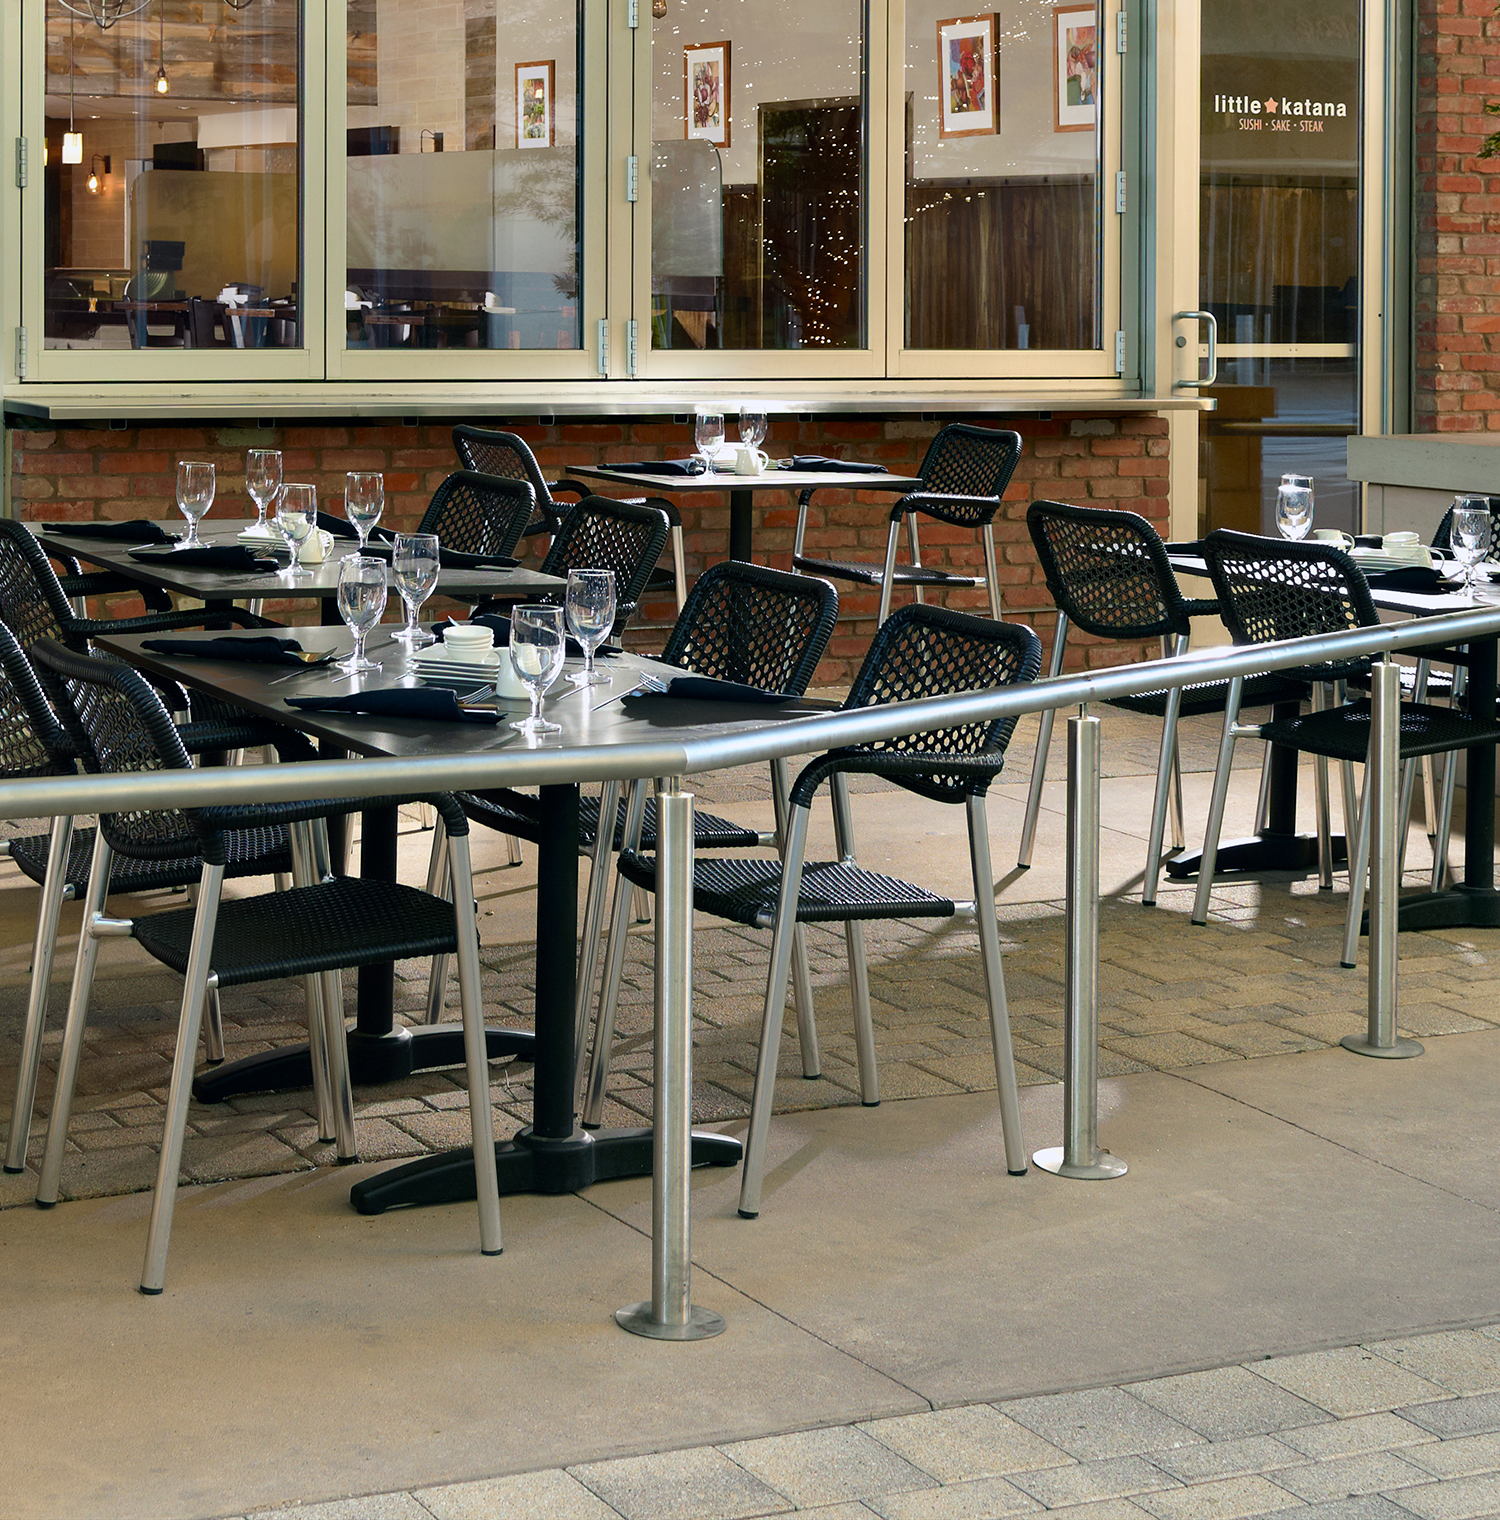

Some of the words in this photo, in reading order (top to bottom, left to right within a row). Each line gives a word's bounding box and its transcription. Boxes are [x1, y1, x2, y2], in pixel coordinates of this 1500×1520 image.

[1214, 94, 1262, 115] little
[1281, 97, 1347, 117] katana
[1239, 118, 1262, 130] SUSHI
[1271, 119, 1291, 131] SAKE
[1300, 120, 1324, 132] STEAK
